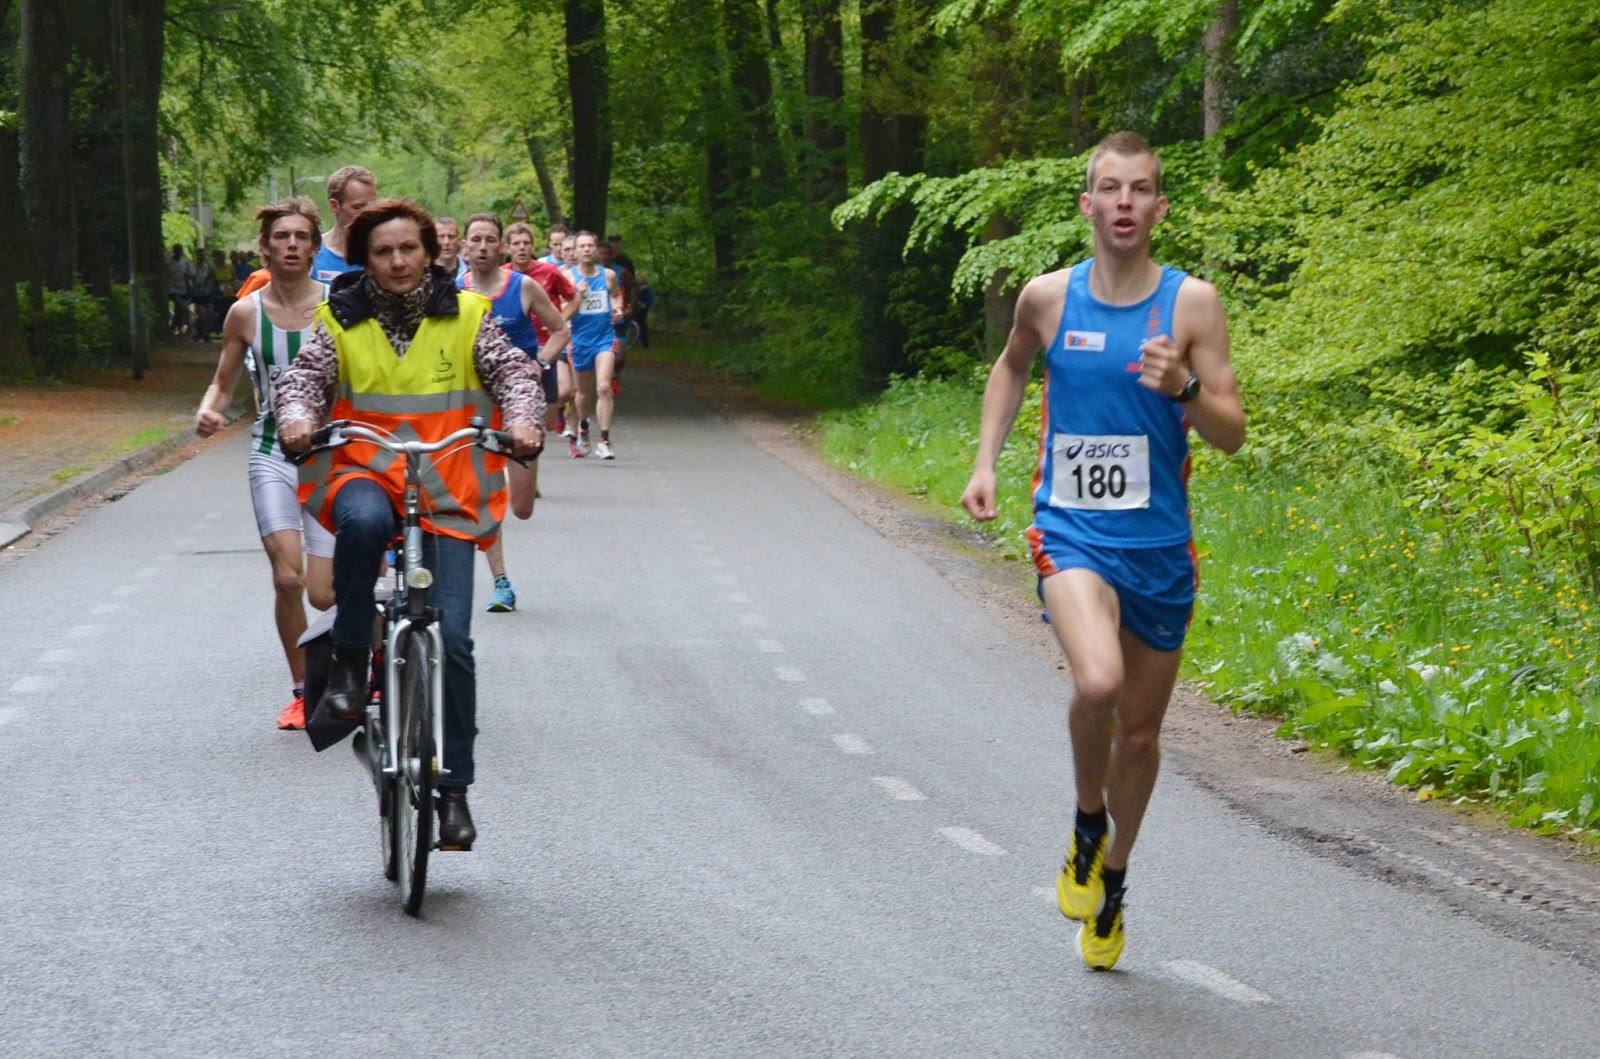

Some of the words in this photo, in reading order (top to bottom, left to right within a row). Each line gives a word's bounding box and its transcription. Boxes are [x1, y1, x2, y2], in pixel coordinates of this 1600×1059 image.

[586, 299, 602, 310] 203
[1085, 443, 1131, 458] asics
[1072, 464, 1126, 499] 180
